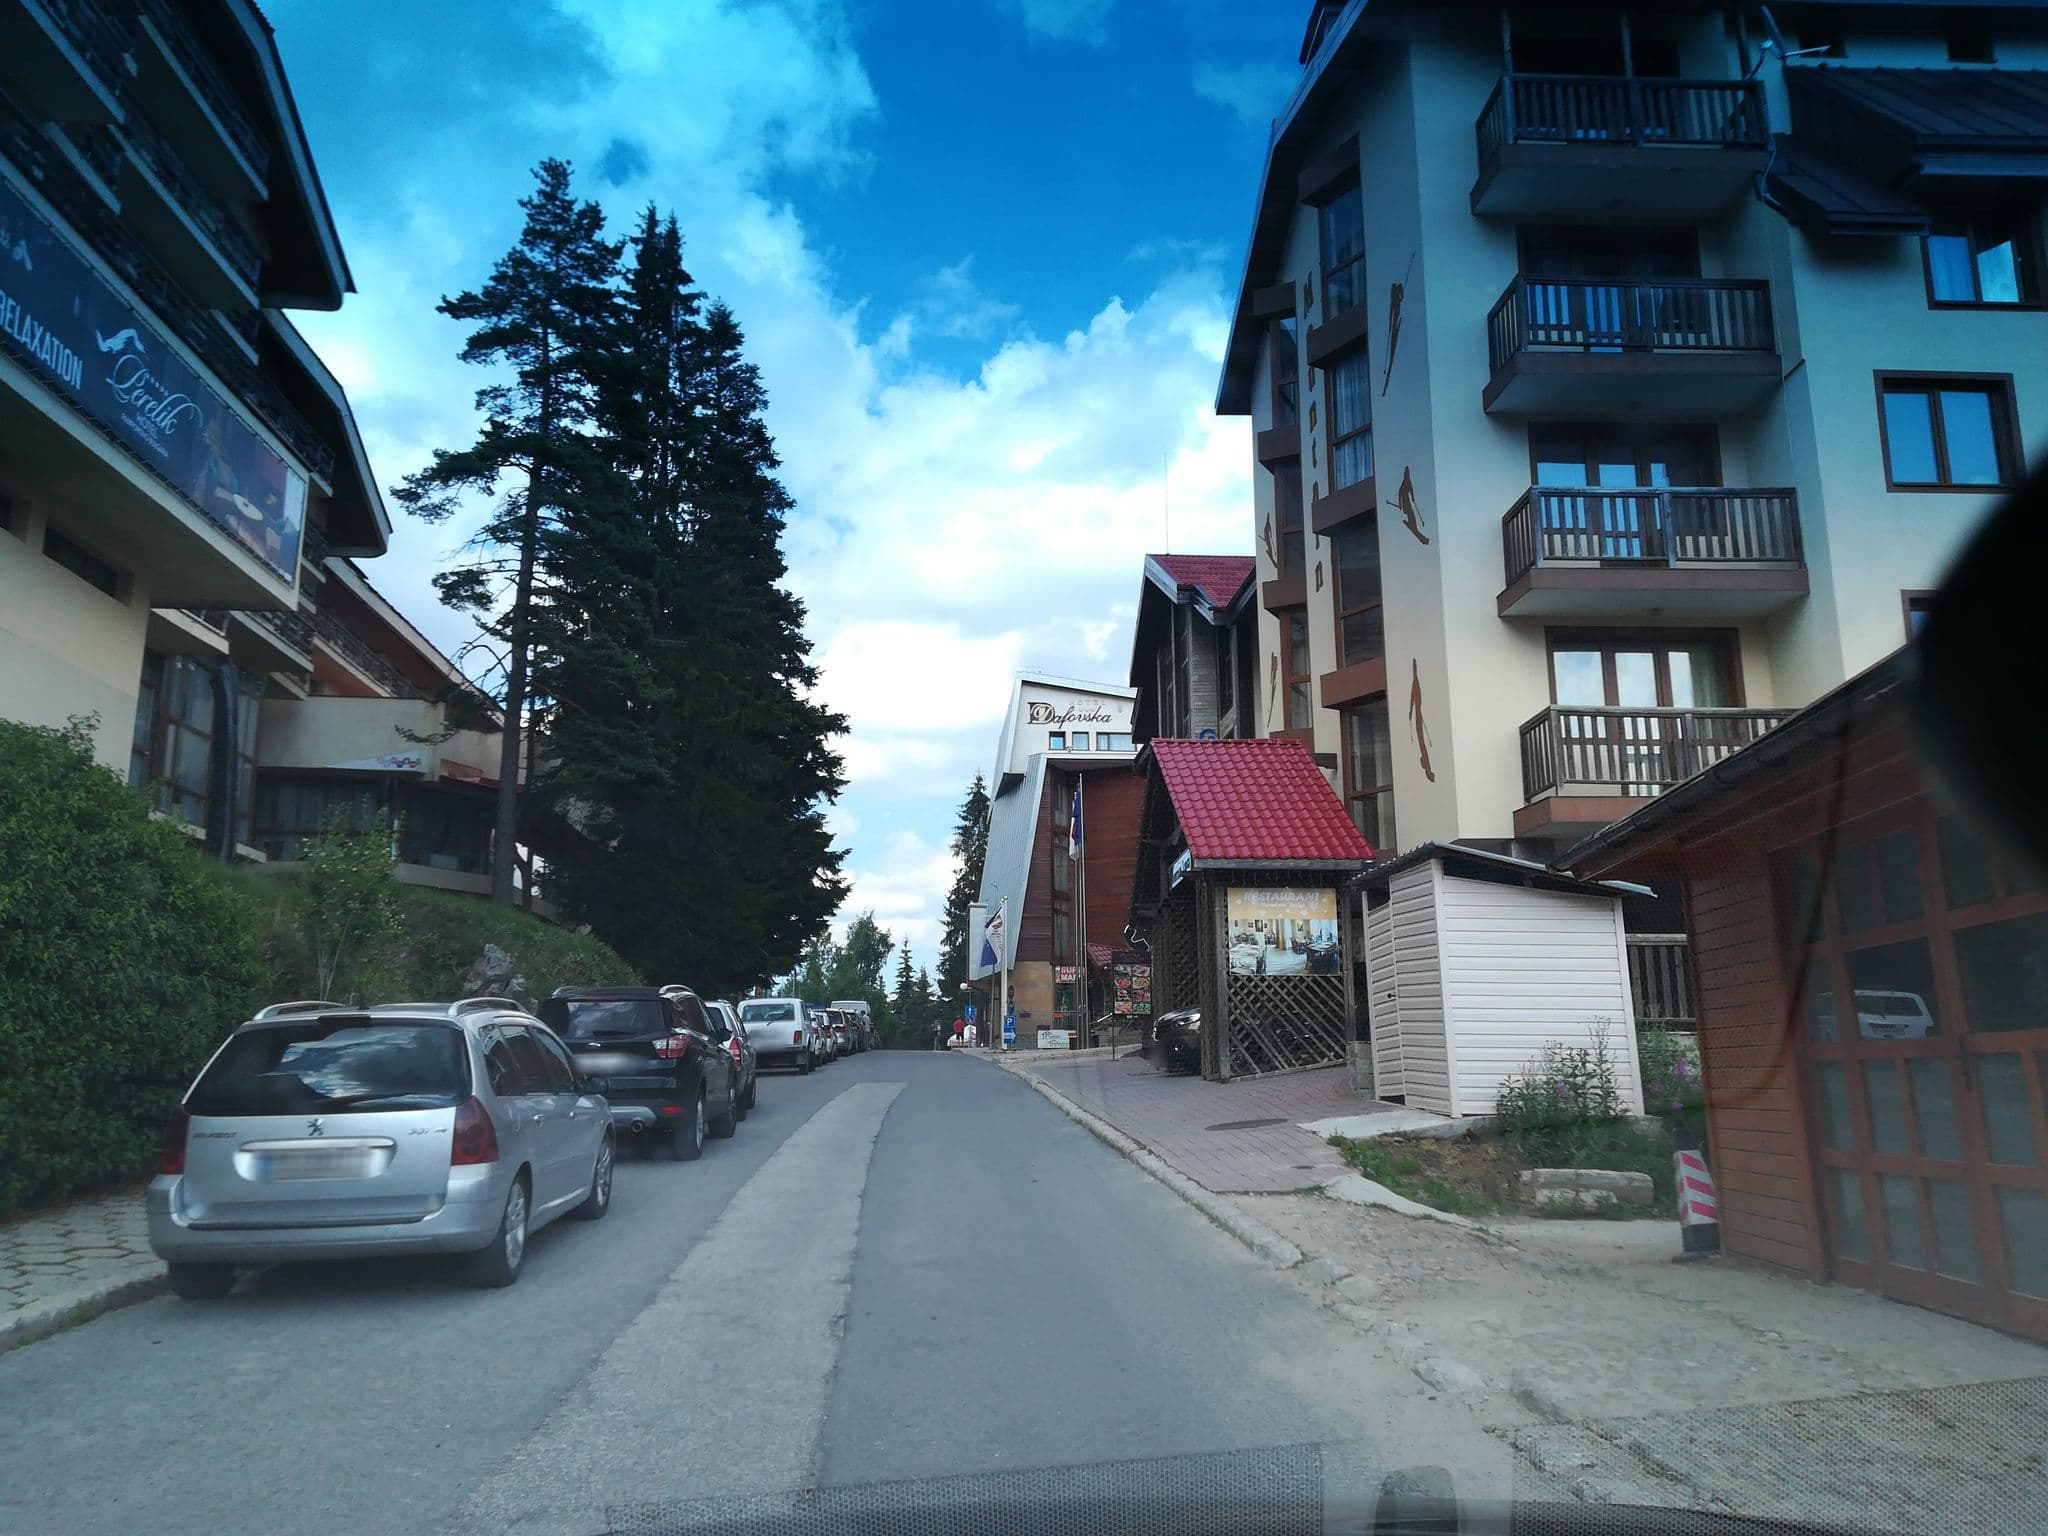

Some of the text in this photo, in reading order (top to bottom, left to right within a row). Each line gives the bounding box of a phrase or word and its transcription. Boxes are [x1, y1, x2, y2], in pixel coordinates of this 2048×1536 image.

[0, 290, 83, 390] RELAXATION
[1027, 702, 1112, 729] Dafovska
[1006, 1017, 1014, 1026] P
